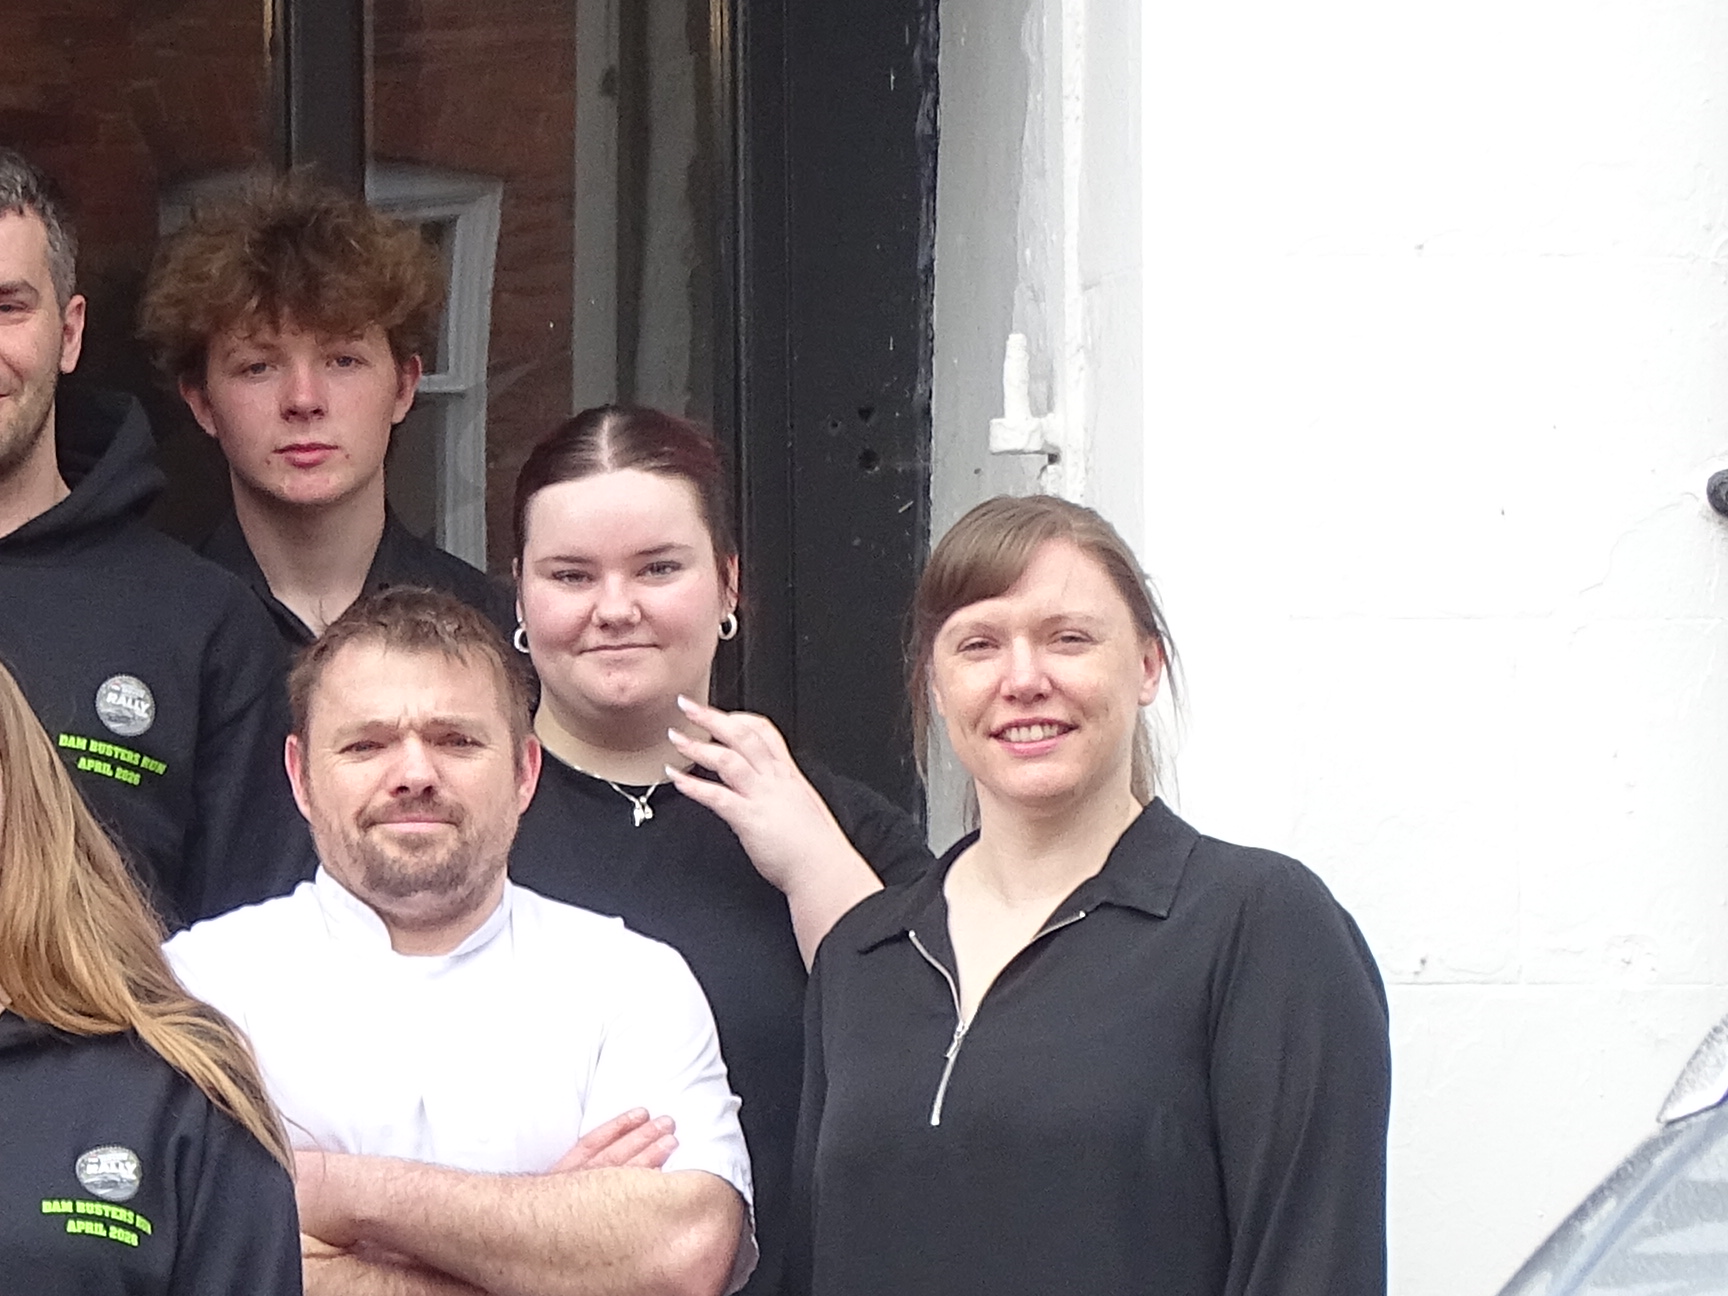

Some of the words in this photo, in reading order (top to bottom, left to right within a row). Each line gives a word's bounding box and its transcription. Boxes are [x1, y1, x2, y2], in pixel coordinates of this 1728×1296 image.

[106, 691, 150, 714] RALLY
[58, 733, 87, 751] DAM
[89, 739, 141, 766] BUSTERS
[140, 755, 167, 776] RUN
[77, 757, 114, 777] APRIL
[85, 1159, 138, 1177] RALLY
[41, 1199, 73, 1214] DAM
[76, 1200, 135, 1225] BUSTERS
[66, 1219, 107, 1237] APRIL
